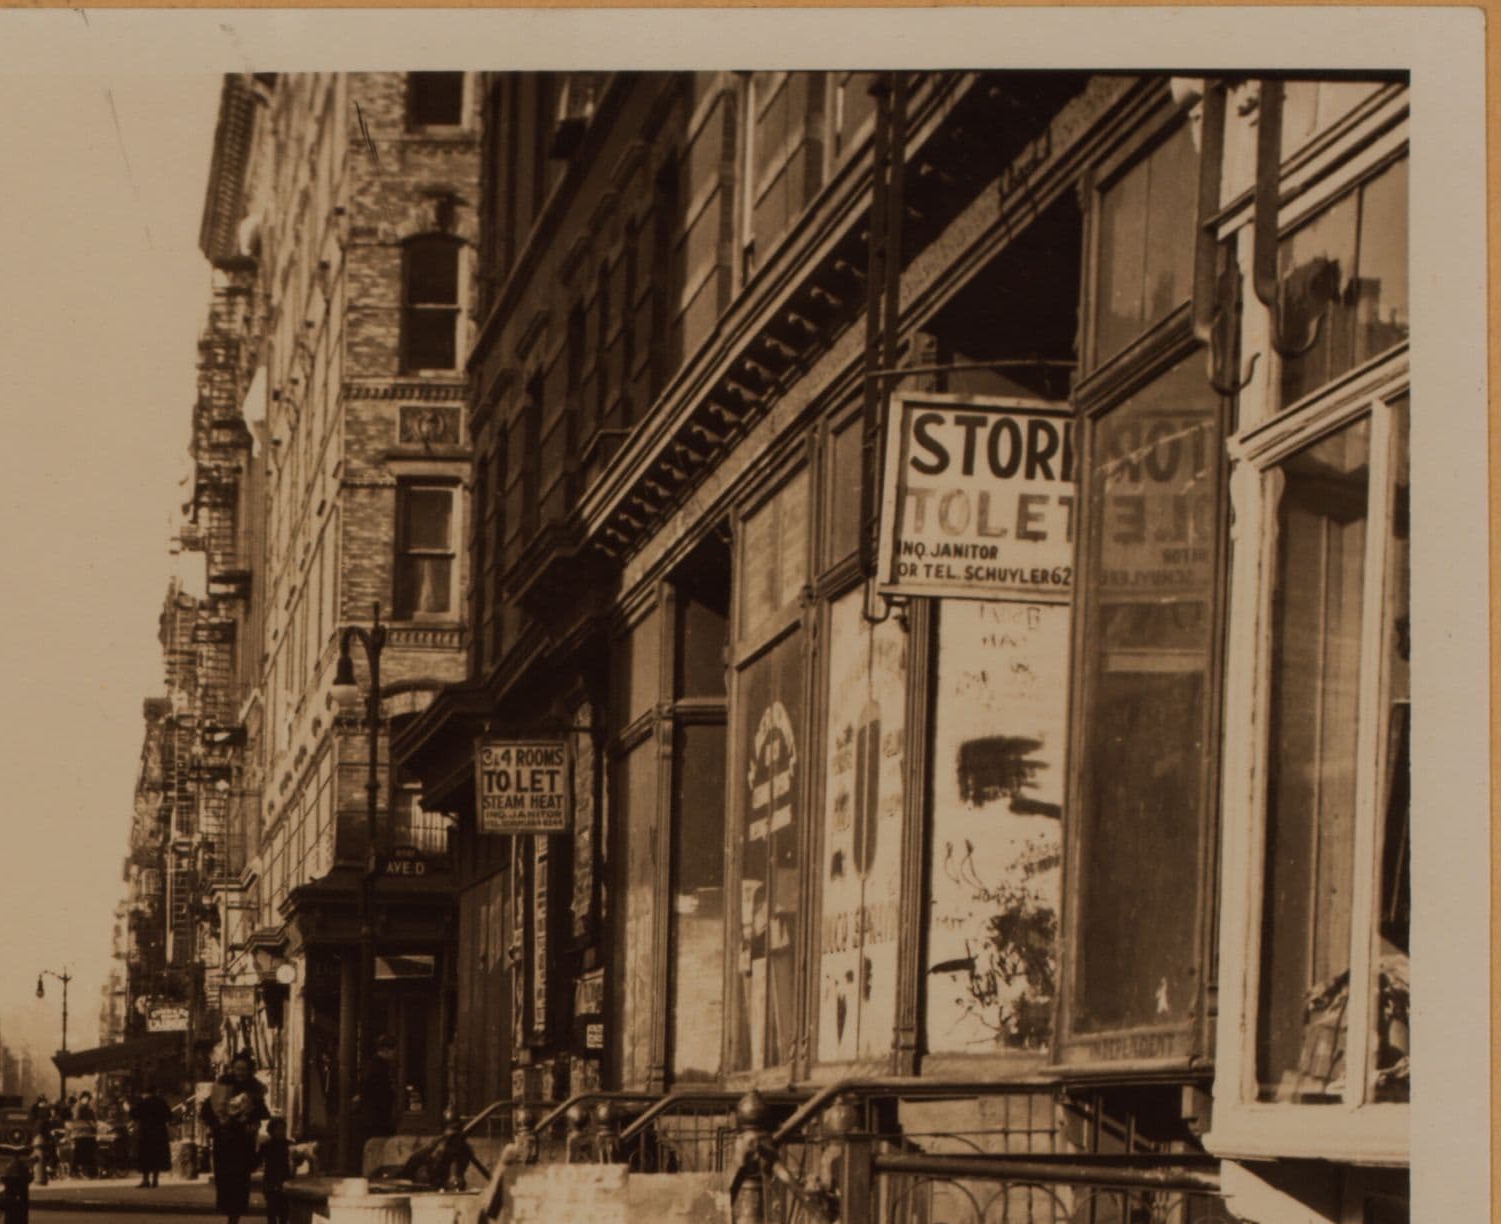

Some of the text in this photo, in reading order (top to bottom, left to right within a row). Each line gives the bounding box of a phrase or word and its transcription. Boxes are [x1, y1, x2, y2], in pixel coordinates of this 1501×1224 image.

[930, 542, 998, 560] JANITOR
[898, 562, 917, 577] OR
[516, 748, 563, 766] ROOMS
[483, 769, 560, 793] TO LET
[483, 794, 563, 809] STEAM HEAT
[509, 810, 562, 818] JANITOR
[415, 861, 425, 876] D
